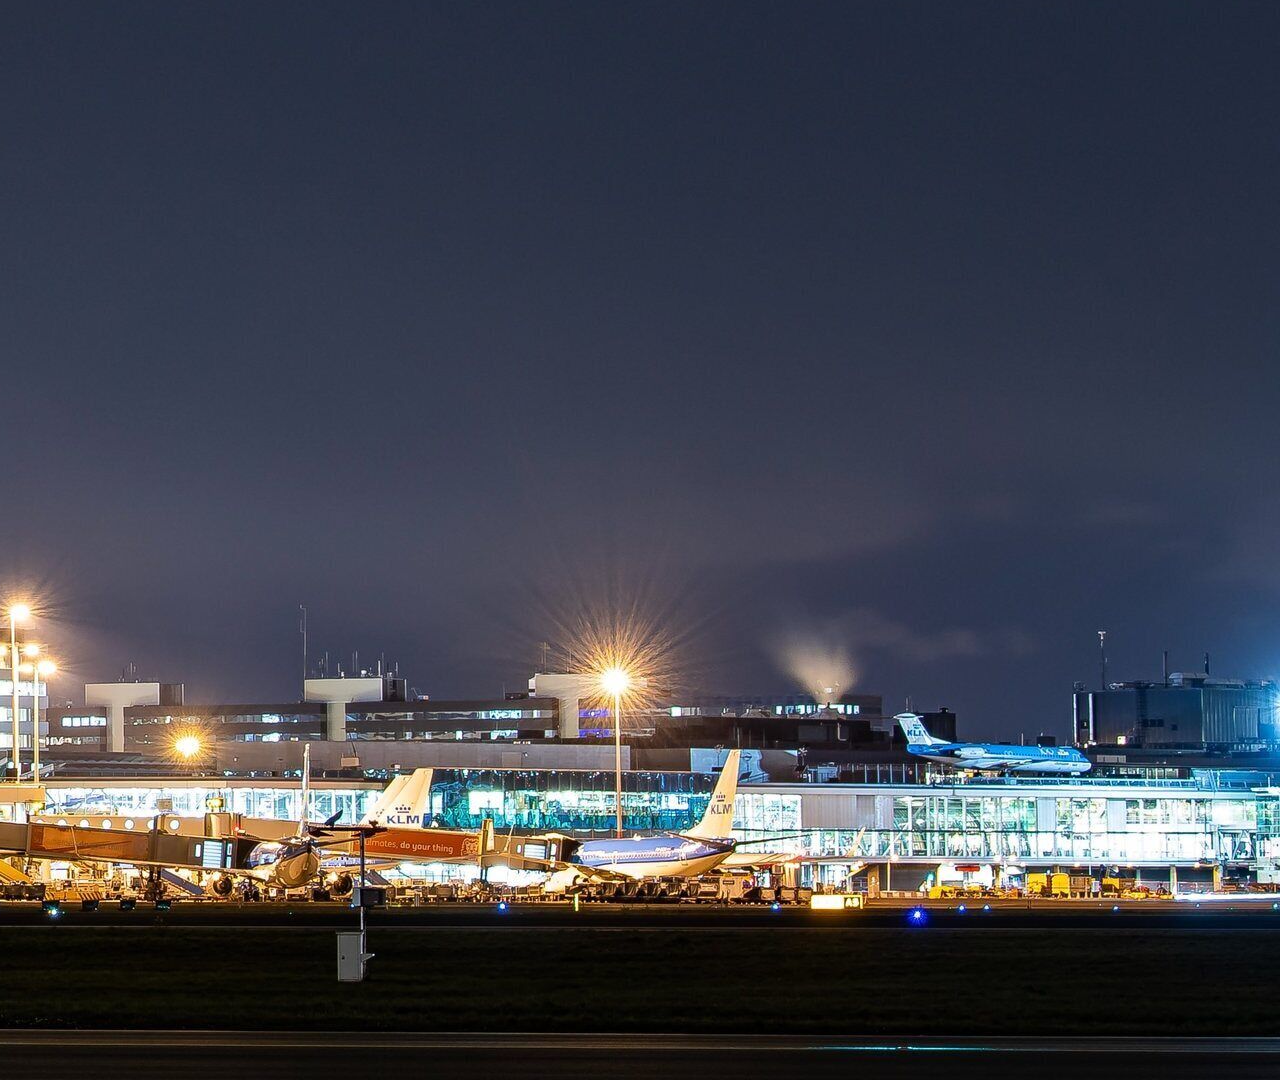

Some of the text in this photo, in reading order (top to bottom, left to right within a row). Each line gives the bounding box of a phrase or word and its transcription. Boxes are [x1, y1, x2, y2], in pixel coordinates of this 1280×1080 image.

[710, 804, 732, 814] KLM
[386, 815, 420, 824] KLM
[400, 841, 410, 849] do
[412, 844, 431, 852] your
[432, 843, 454, 854] thing
